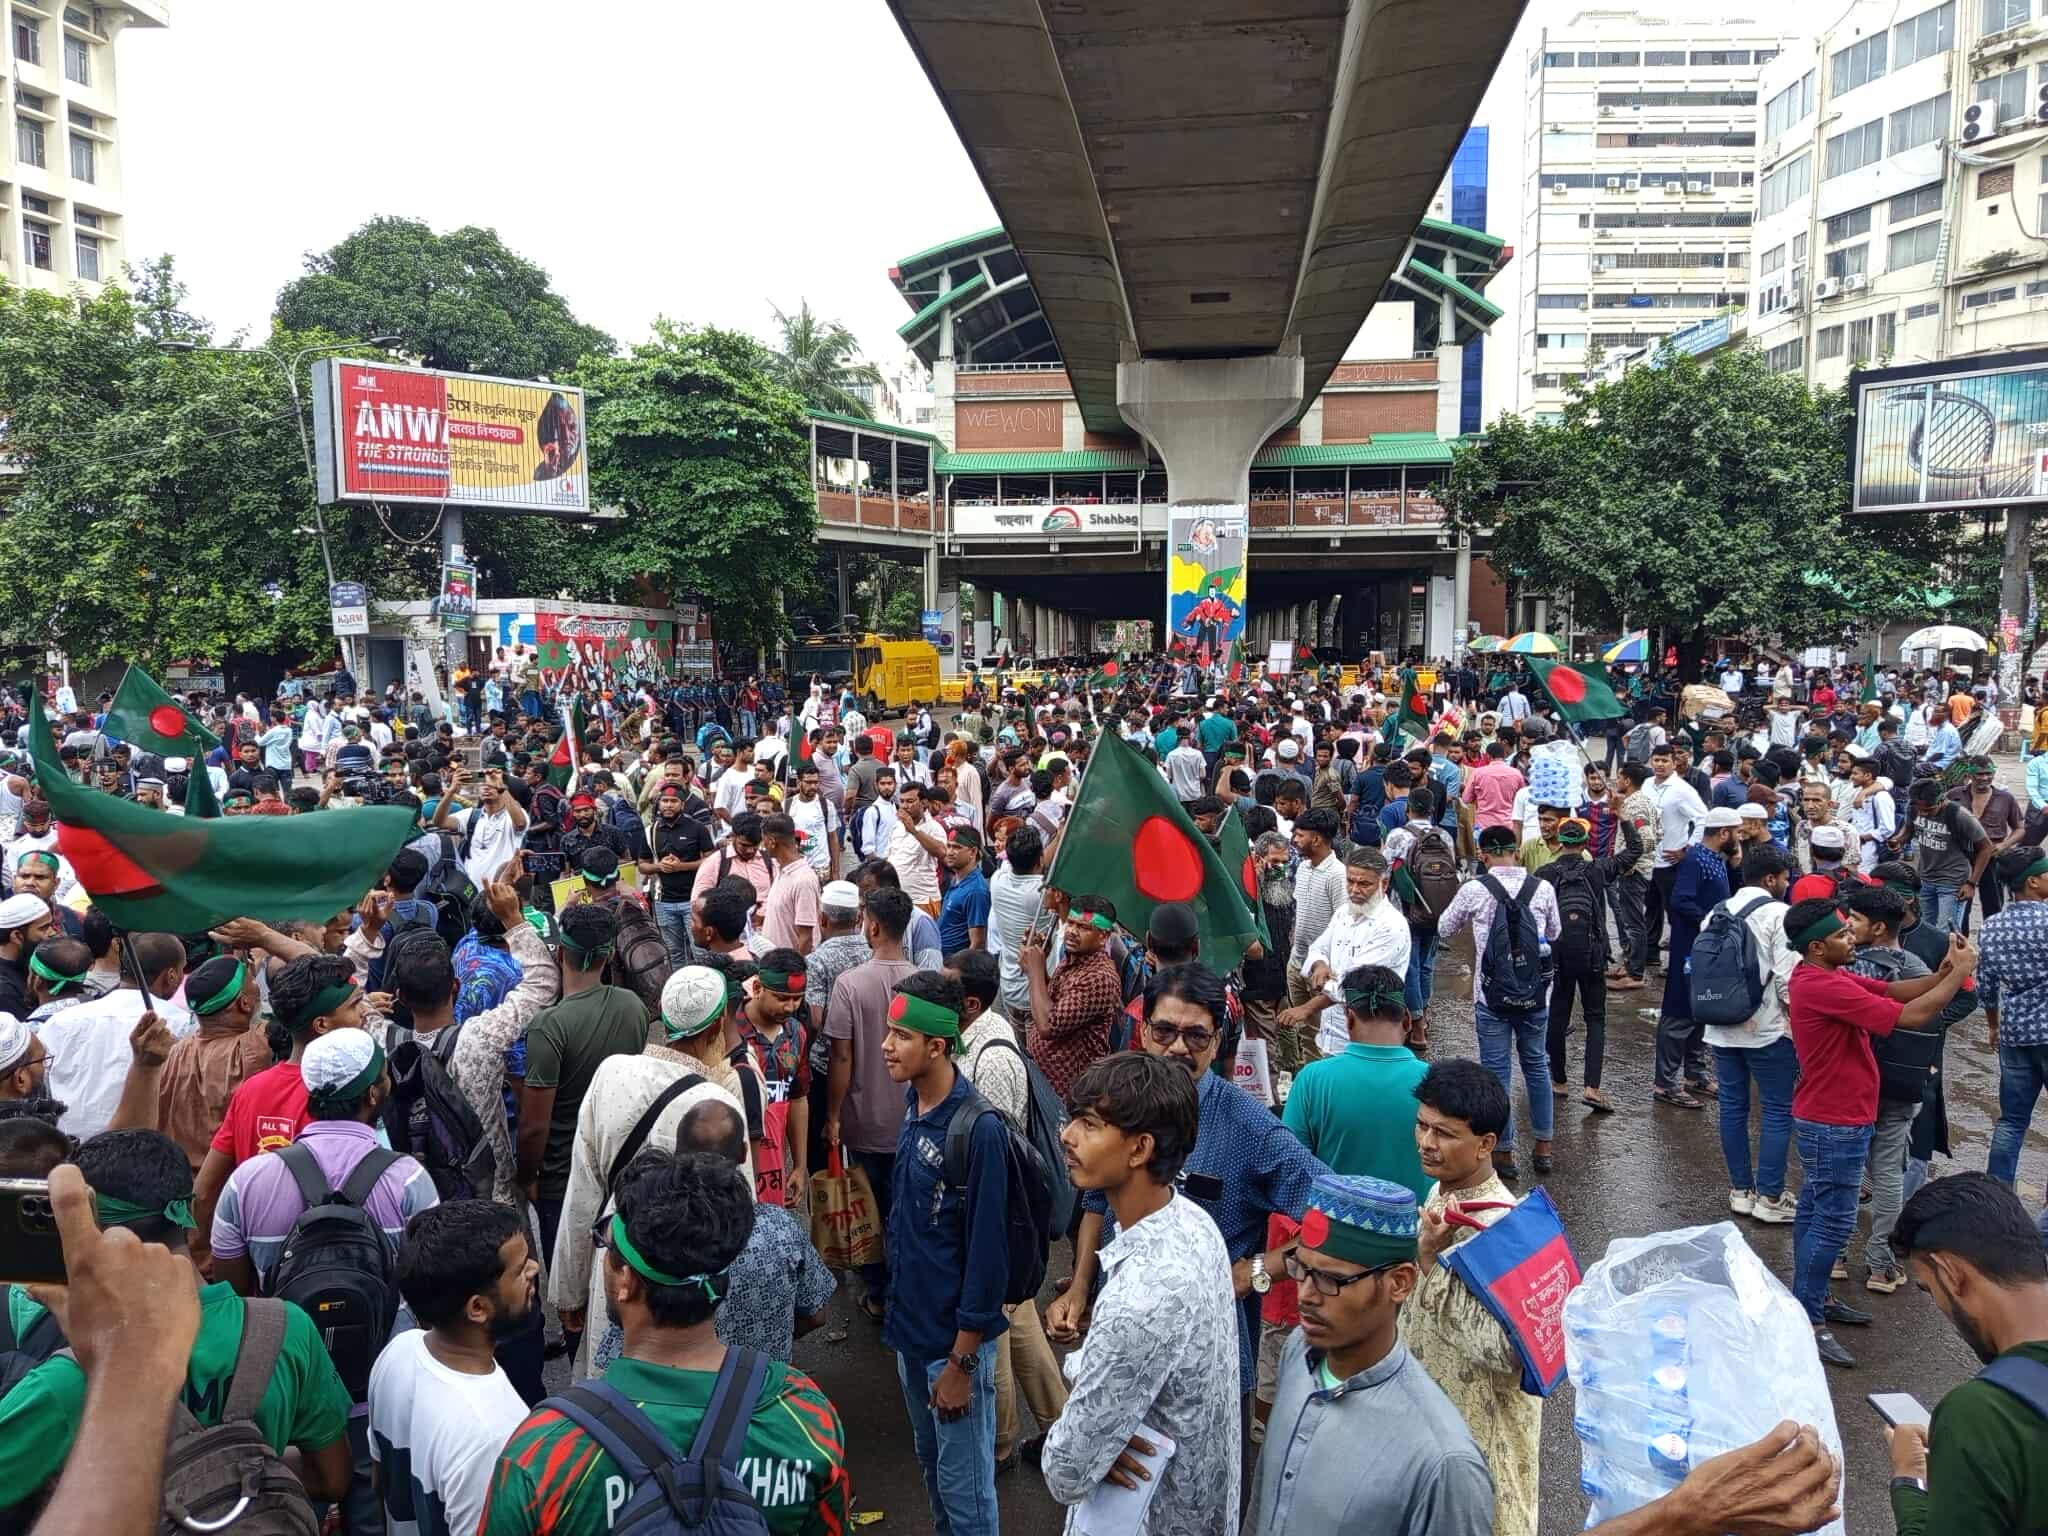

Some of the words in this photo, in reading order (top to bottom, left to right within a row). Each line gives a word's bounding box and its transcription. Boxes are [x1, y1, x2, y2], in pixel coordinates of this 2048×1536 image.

[355, 400, 449, 444] ANW
[356, 441, 383, 459] THE
[386, 444, 449, 464] STRONGE
[994, 514, 1033, 527] শাহবাগ
[1089, 513, 1138, 526] Shahbag
[1927, 819, 1951, 835] VEGA
[1916, 836, 1948, 851] AIDERS
[1233, 1064, 1253, 1077] RO
[262, 1121, 277, 1131] ALL
